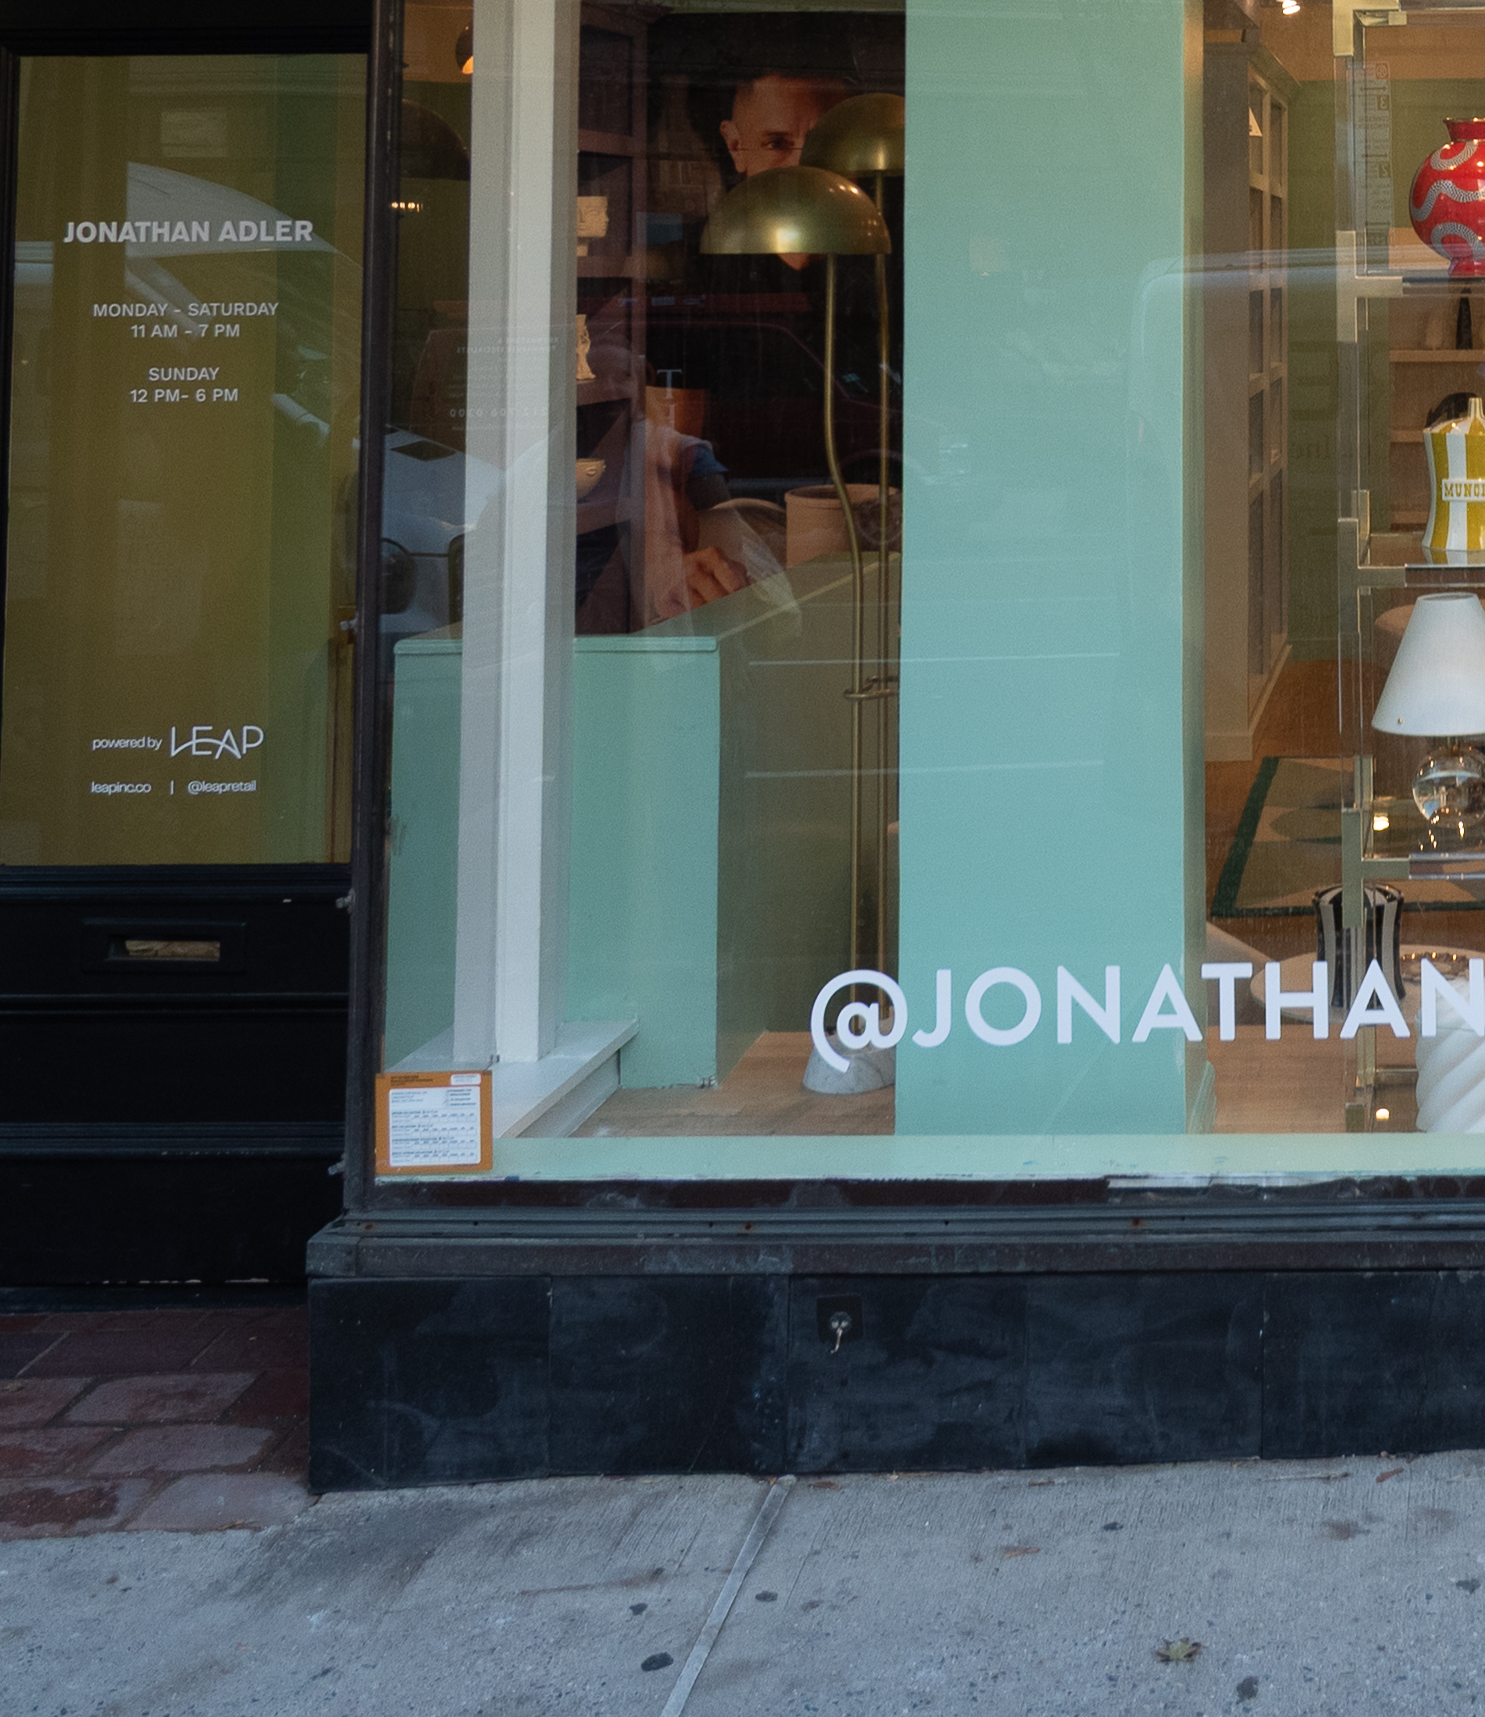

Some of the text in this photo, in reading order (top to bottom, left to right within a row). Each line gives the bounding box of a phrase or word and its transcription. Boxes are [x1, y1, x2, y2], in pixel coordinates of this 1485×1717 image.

[63, 220, 313, 244] JONATHAN ADLER
[93, 303, 168, 317] MONDAY
[188, 302, 279, 317] SATURDAY
[131, 324, 146, 338] 11
[151, 324, 178, 338] AM
[198, 324, 209, 338] 7
[214, 324, 240, 338] PM
[148, 367, 220, 382] SUNDAY
[130, 389, 148, 403] 12
[195, 388, 206, 403] 6
[212, 388, 239, 403] PM
[92, 725, 264, 760] powered by LEAP
[187, 780, 258, 795] @leapretail
